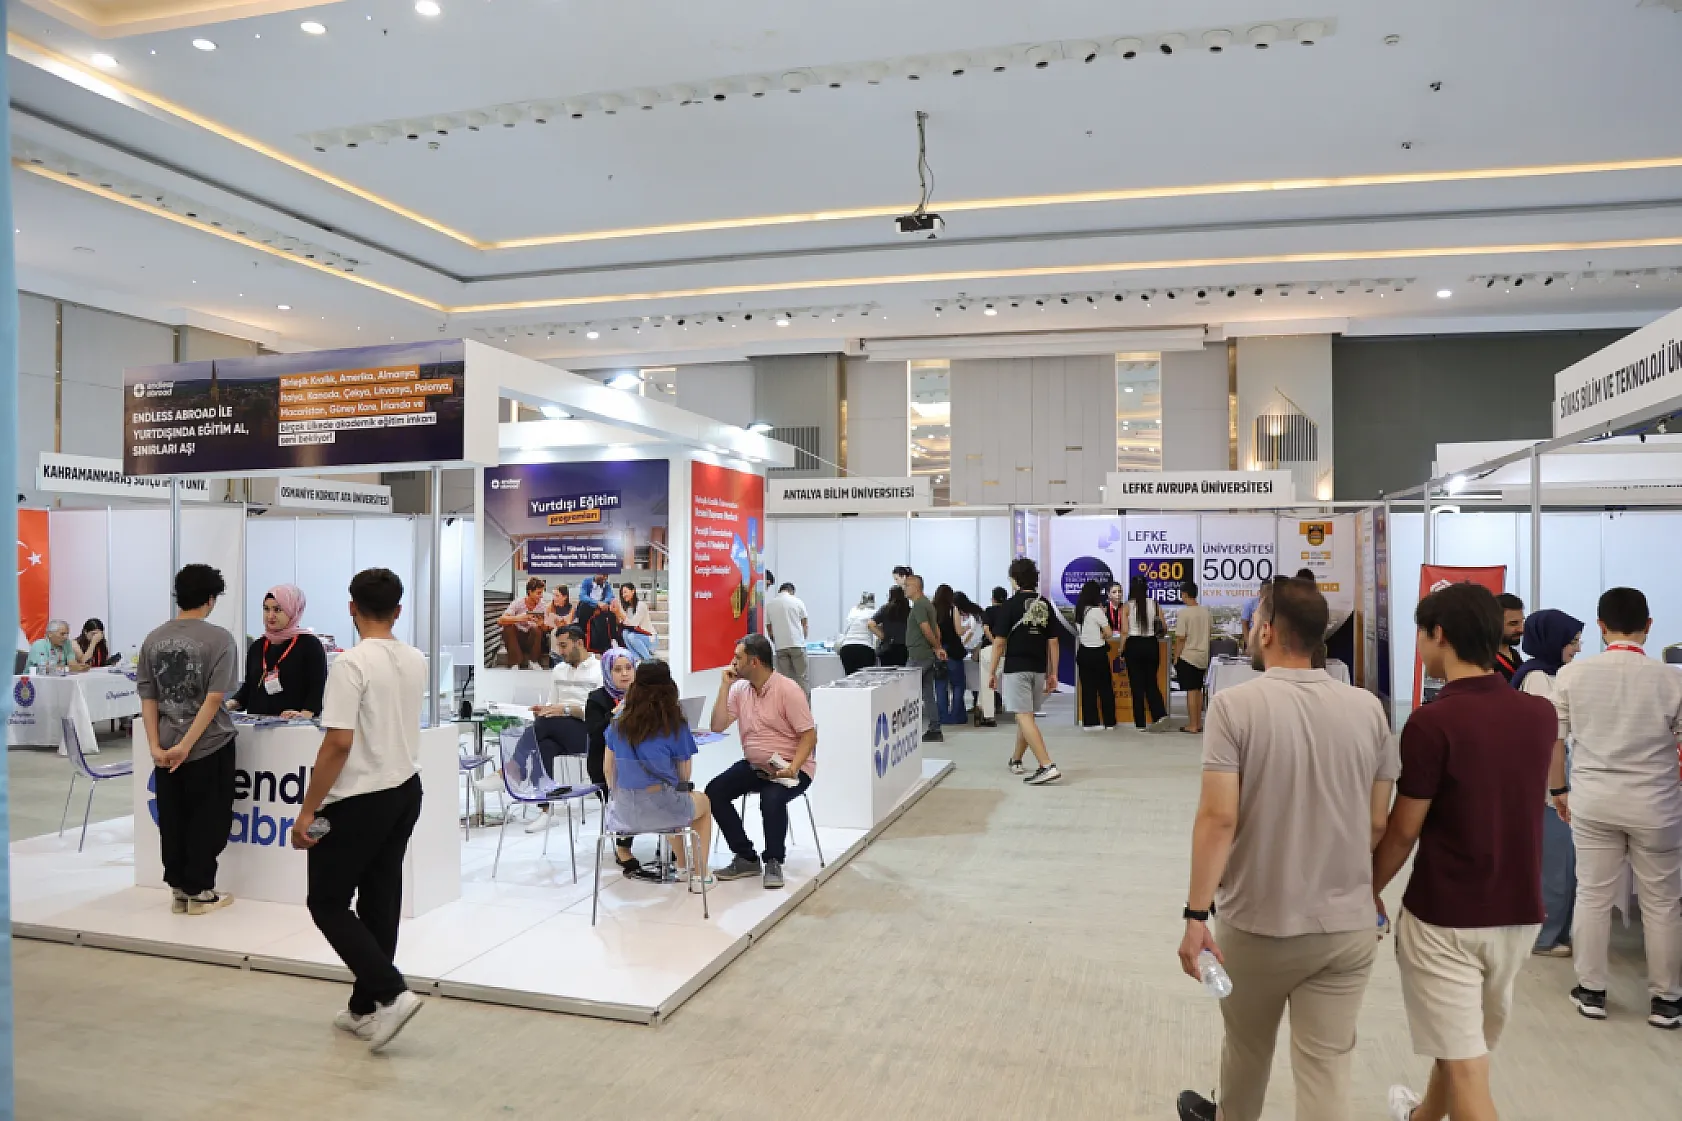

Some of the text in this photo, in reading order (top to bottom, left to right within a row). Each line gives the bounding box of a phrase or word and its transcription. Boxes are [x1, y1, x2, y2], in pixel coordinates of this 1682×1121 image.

[1581, 376, 1602, 411] BİLİM
[1603, 373, 1614, 401] VE
[1615, 342, 1665, 396] TEKNOLOJİ
[132, 404, 233, 424] ENDLESS ABROAD İLE
[133, 422, 249, 441] YURTDIŞINDA EĞİTİM AL,
[132, 442, 196, 457] SINIRLARI AŞ!
[281, 486, 314, 500] OSMANİYE
[352, 491, 389, 505] ÜNİVERSİTESİ
[783, 485, 915, 500] ANTALYA BİLİM ÜNİVERSİTESİ
[1122, 480, 1273, 494] LEFKE AVRUPA ÜNİVERSİTESİ
[531, 493, 619, 513] Yurtdışı Eğitim
[1127, 530, 1167, 542] LEFKE
[1144, 542, 1274, 555] AVRUPA ÜNİVERSİTESİ
[1138, 561, 1184, 580] %80
[1202, 558, 1273, 581] 5000
[892, 698, 919, 734] endless
[891, 728, 918, 767] abroad
[227, 806, 295, 847] abr
